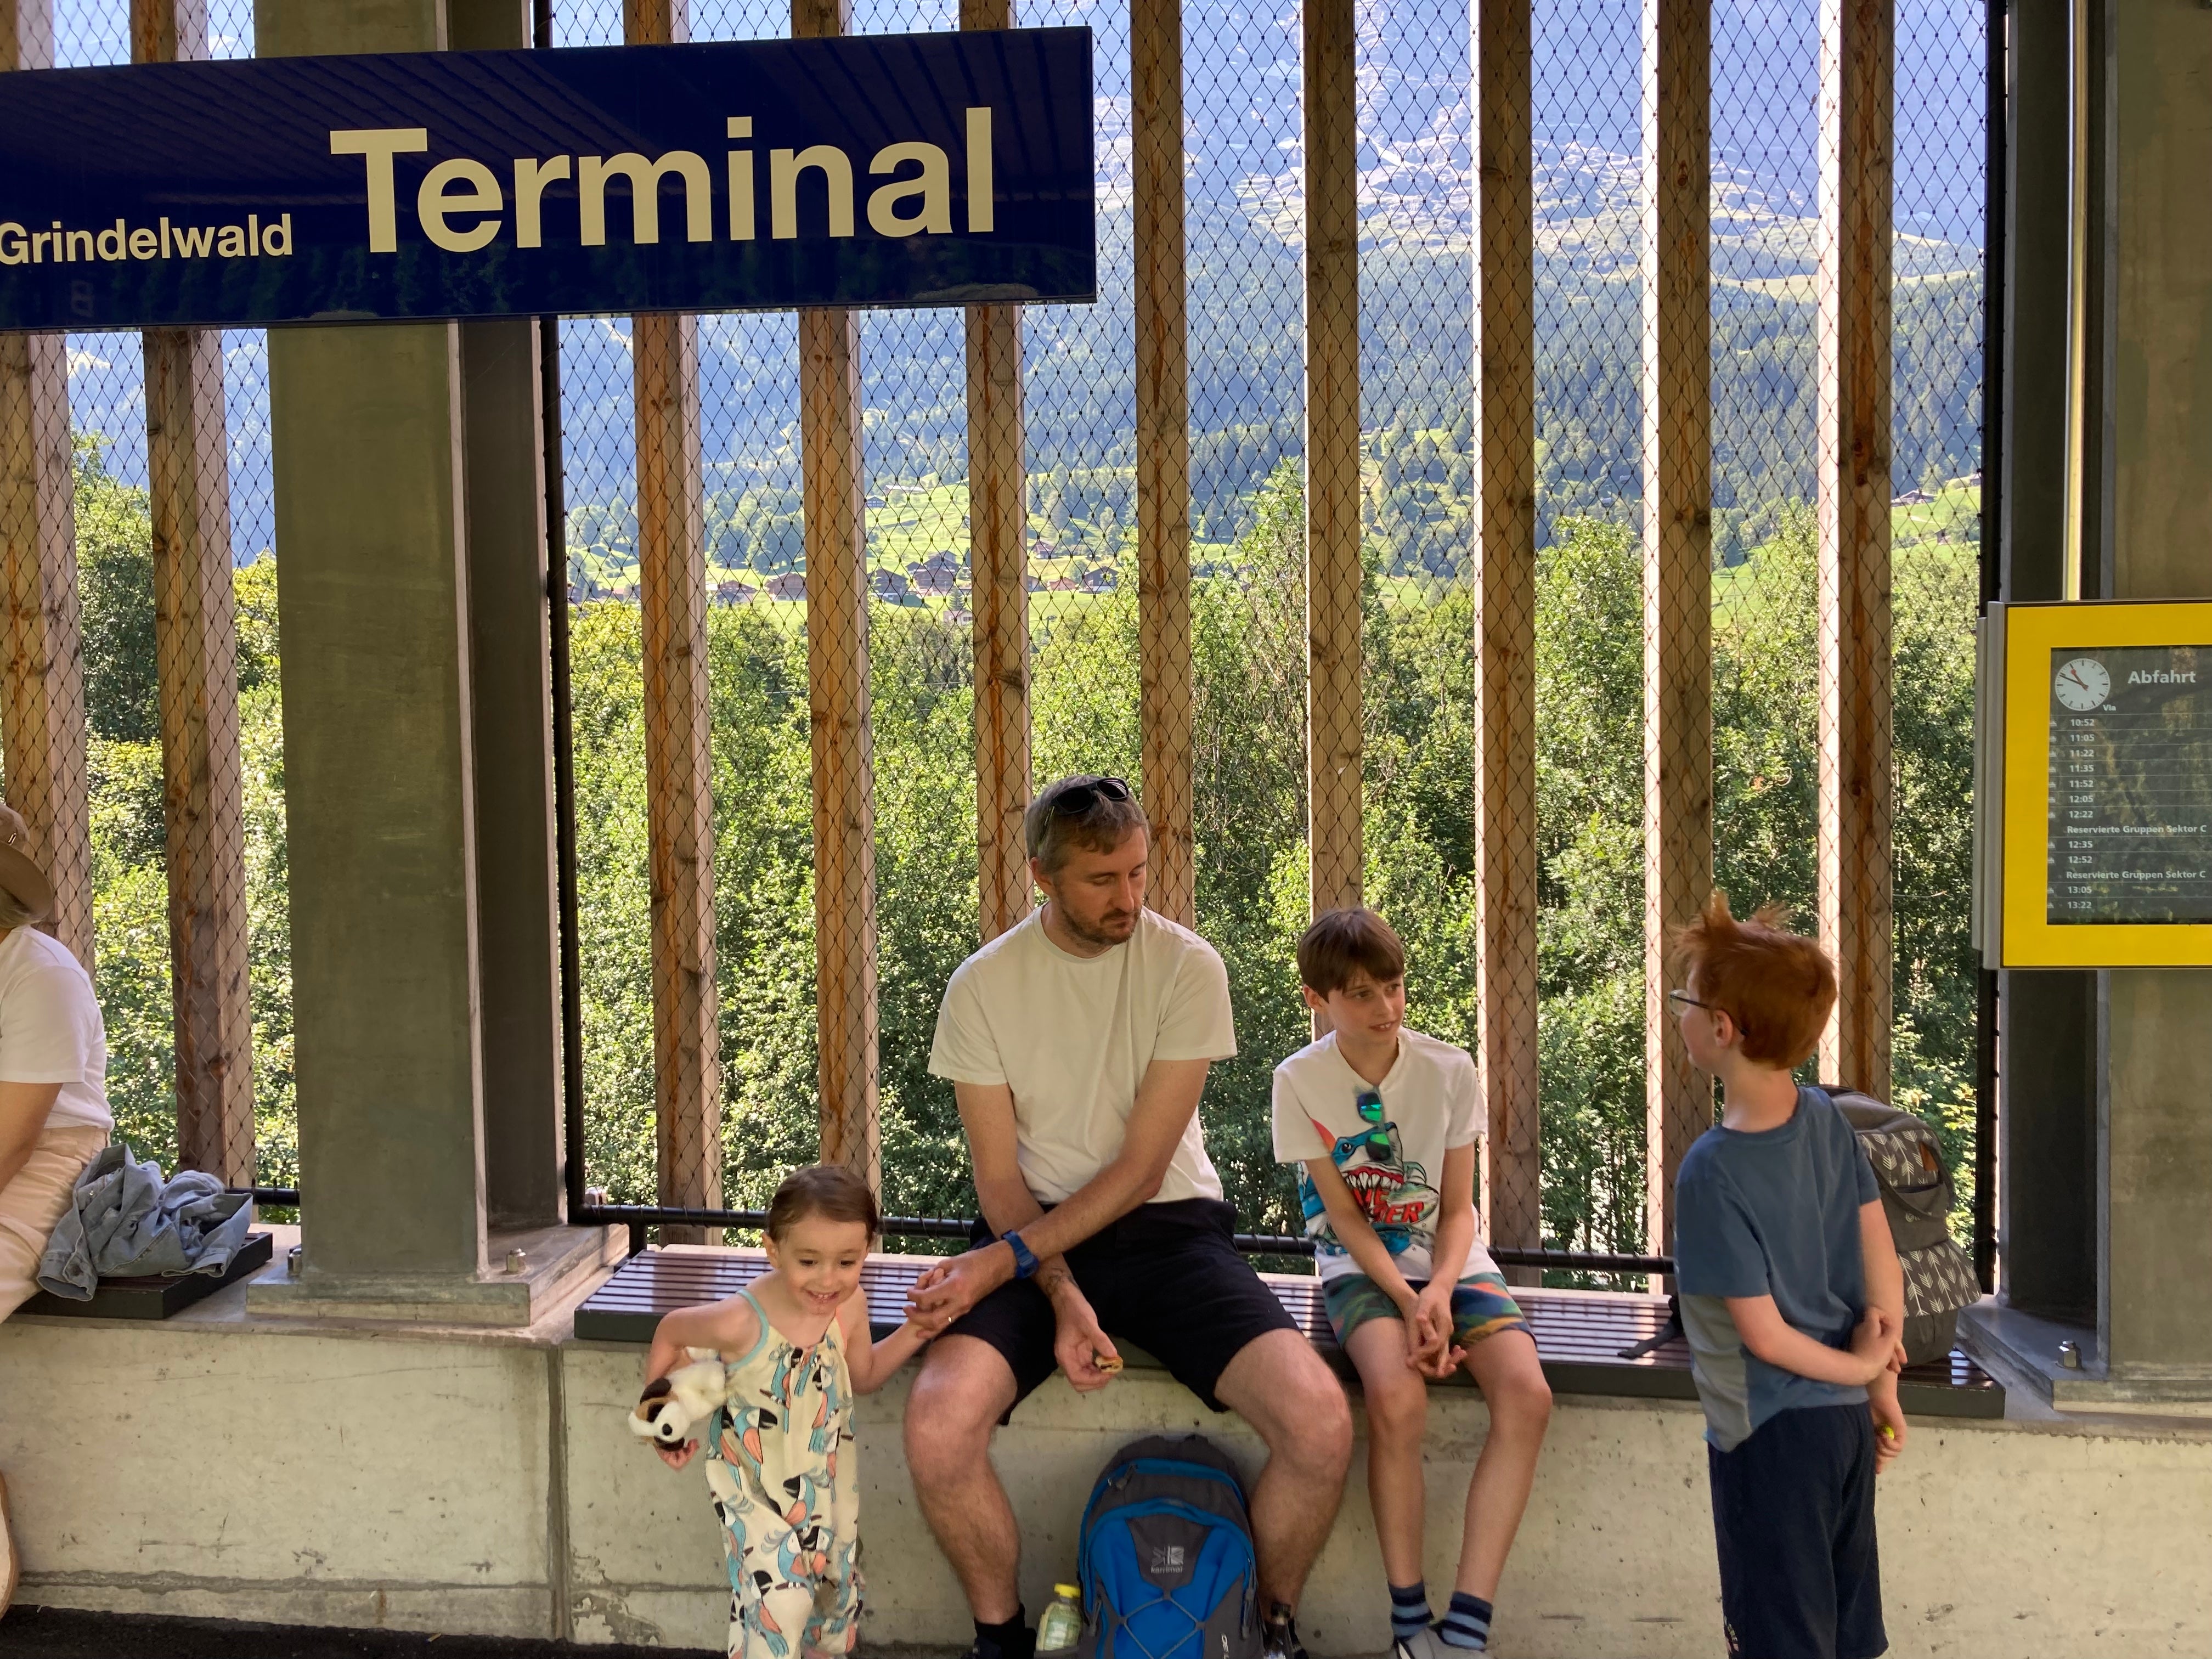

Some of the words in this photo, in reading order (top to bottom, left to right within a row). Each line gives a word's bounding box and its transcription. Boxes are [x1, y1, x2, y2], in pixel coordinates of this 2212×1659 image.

[0, 213, 292, 266] Grindelwald
[330, 106, 995, 253] Terminal
[2128, 670, 2196, 684] Abfahrt
[2123, 825, 2164, 834] Gruppen
[2166, 825, 2197, 833] Sektor
[2122, 871, 2163, 881] Gruppen
